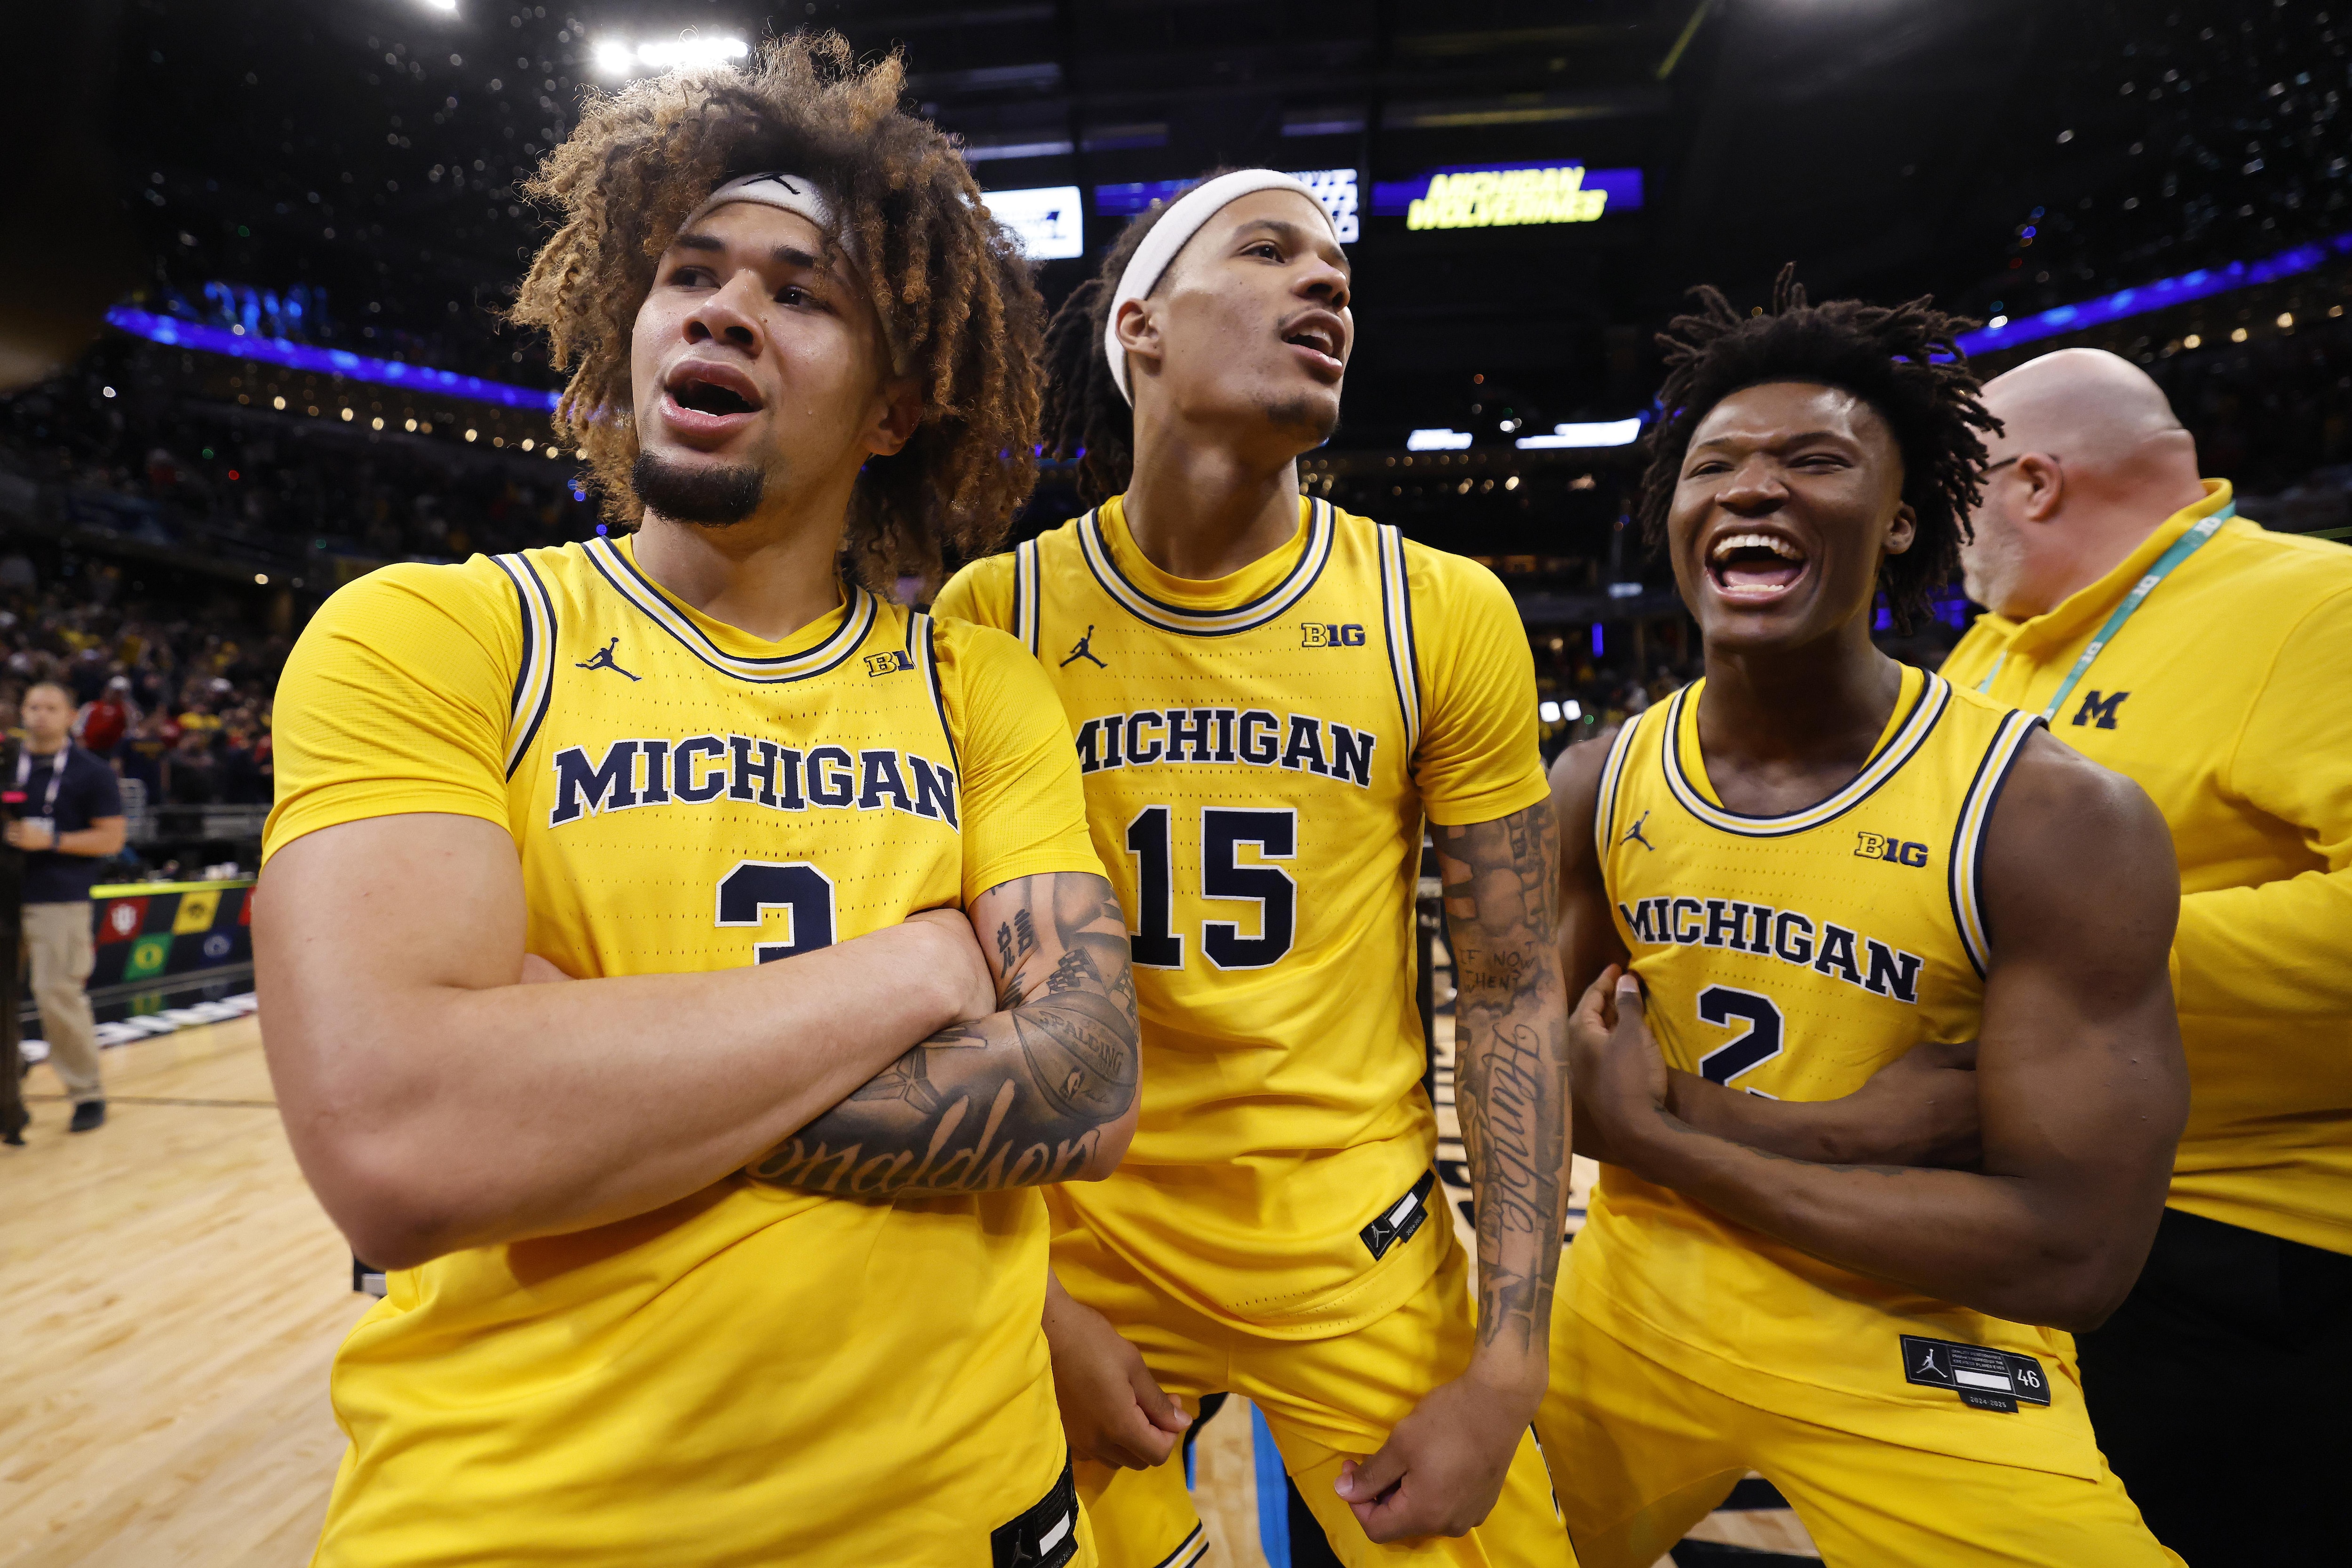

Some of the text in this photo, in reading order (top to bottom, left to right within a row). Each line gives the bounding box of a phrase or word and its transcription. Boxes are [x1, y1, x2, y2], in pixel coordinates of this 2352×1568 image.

[2072, 690, 2131, 729] M
[548, 733, 960, 834] MICHIGAN
[1126, 805, 1297, 971] 15
[1618, 896, 1925, 1004] MICHIGAN
[1697, 984, 1784, 1100] 2
[747, 1078, 1100, 1194] onaldson
[1970, 1396, 2007, 1409] 2024-2025
[2017, 1369, 2041, 1389] 46
